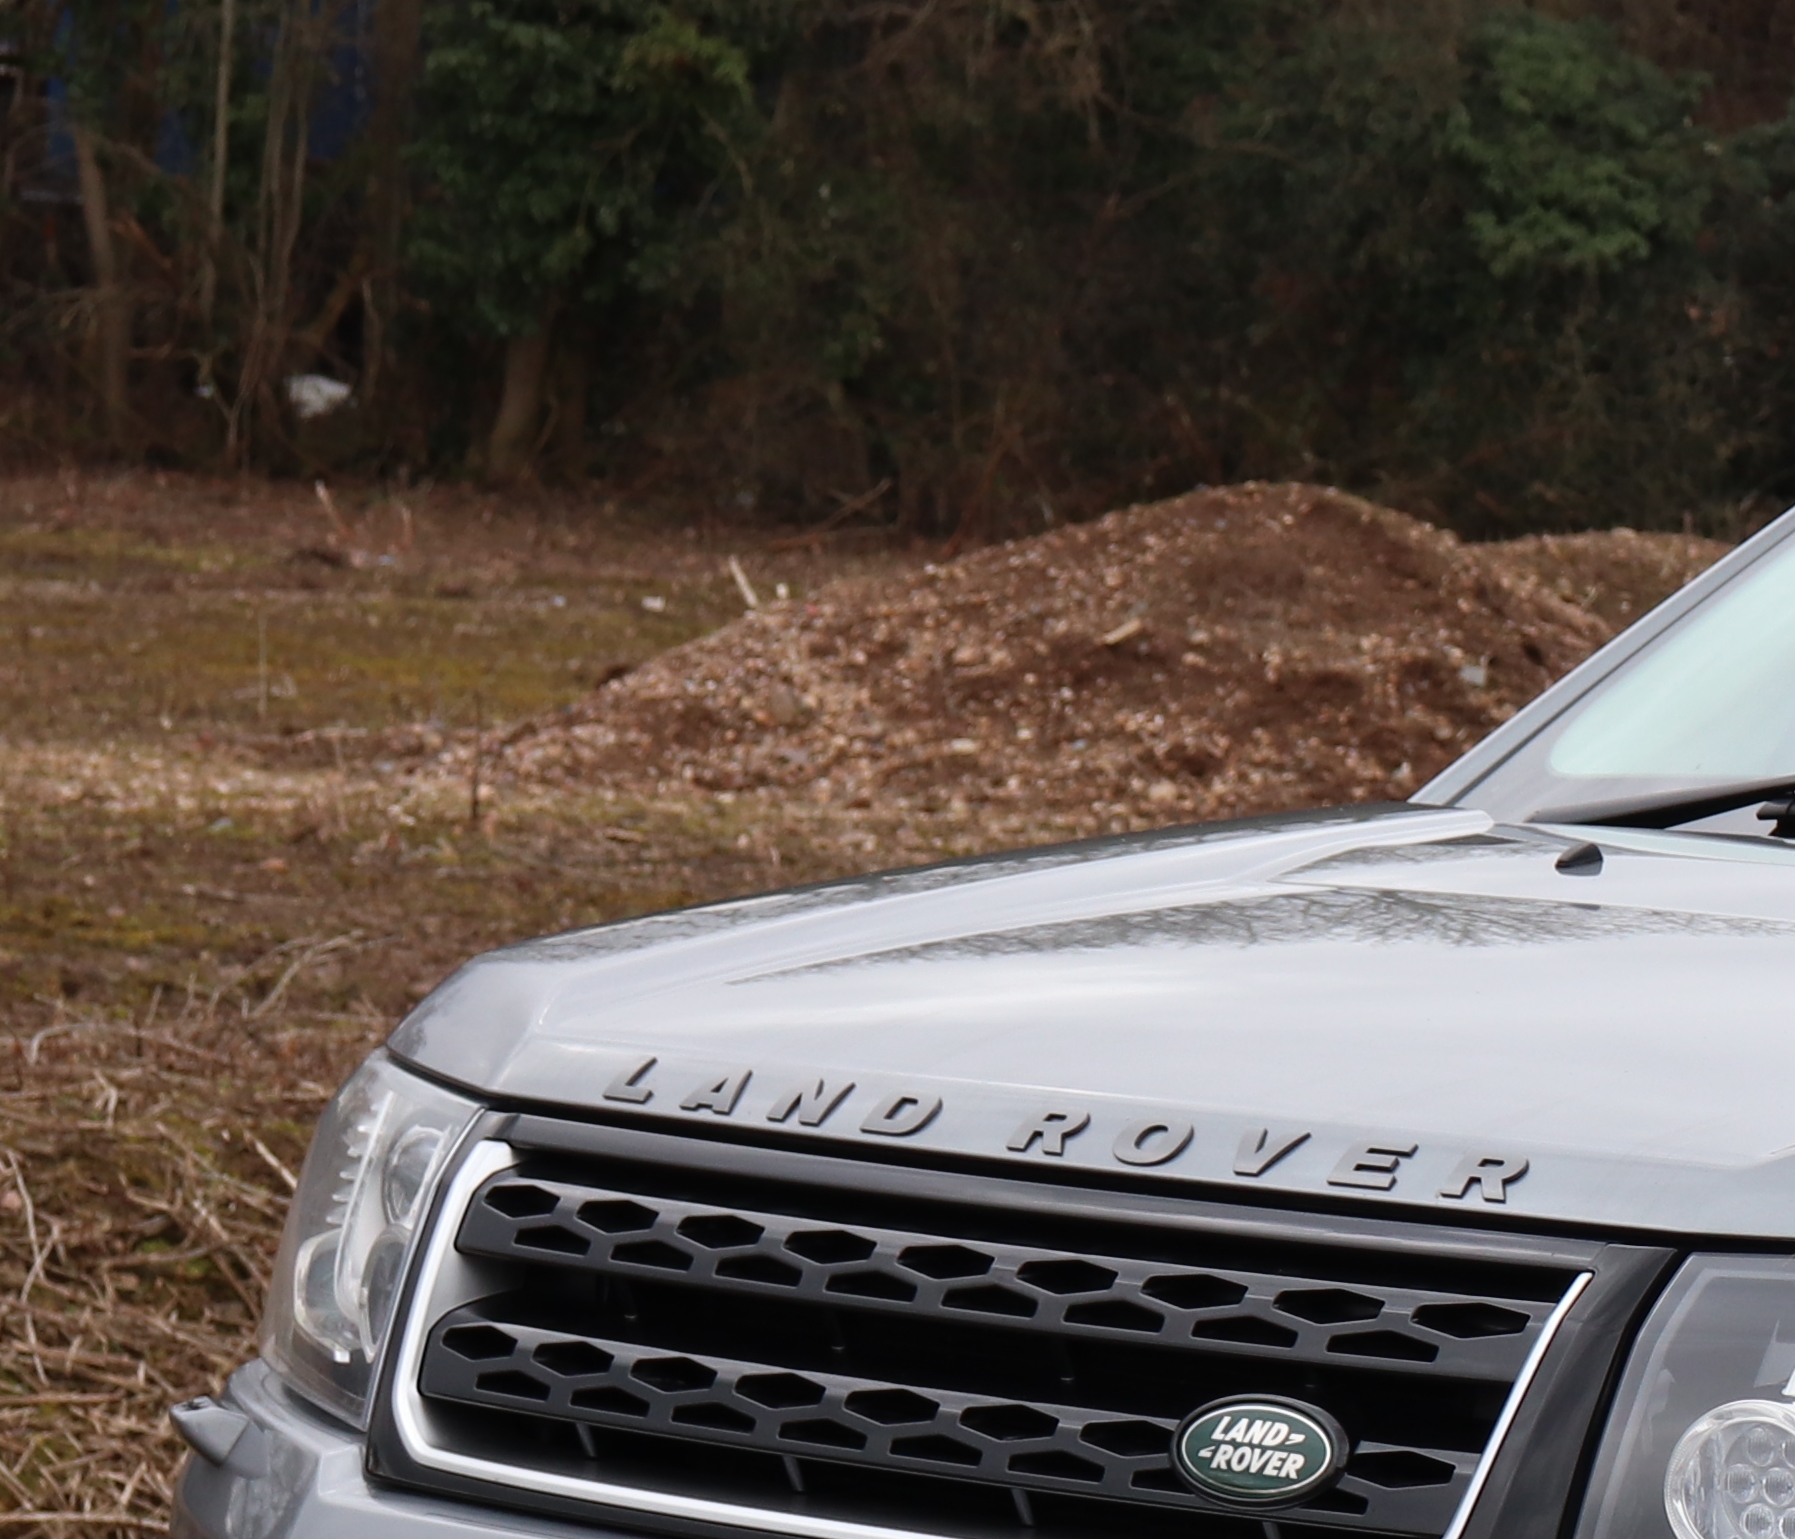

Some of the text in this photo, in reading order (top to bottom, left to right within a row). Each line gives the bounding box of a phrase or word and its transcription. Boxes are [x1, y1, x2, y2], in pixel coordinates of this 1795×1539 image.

[602, 1057, 1530, 1203] LAND ROVER
[1211, 1416, 1289, 1446] LAND
[1210, 1444, 1305, 1479] ROVER
